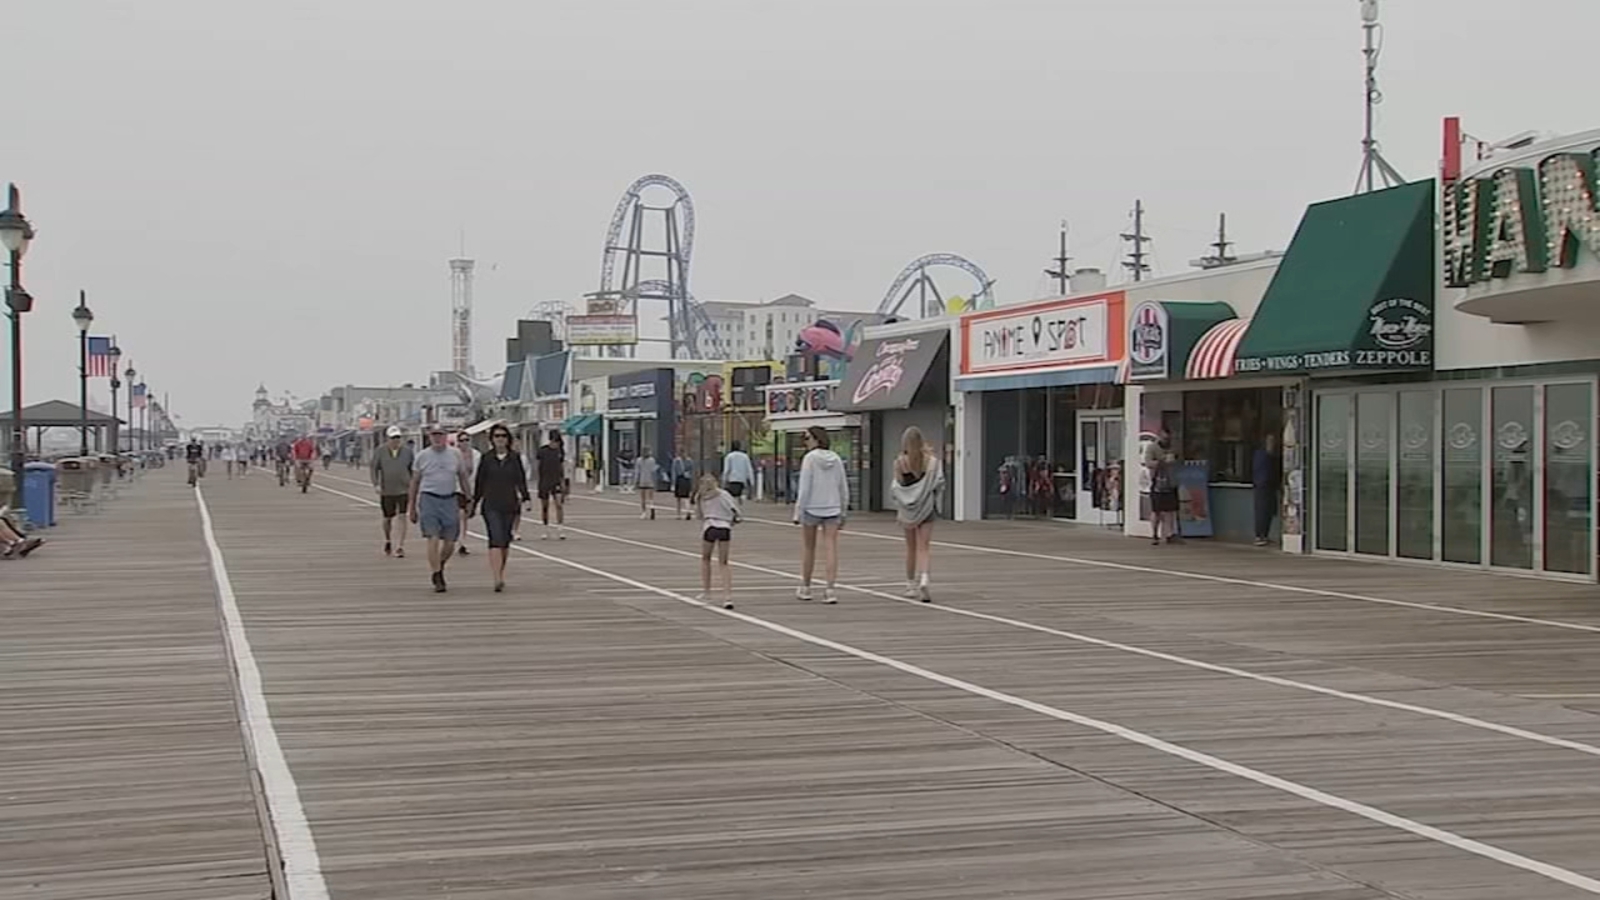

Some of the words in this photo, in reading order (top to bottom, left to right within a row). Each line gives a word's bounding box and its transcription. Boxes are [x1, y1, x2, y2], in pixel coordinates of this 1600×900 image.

[984, 325, 1025, 359] ANIME
[1048, 316, 1087, 351] SPOT
[1266, 355, 1299, 370] WINGS
[1304, 350, 1350, 368] TENDERS
[1355, 350, 1431, 365] ZEPPOLE
